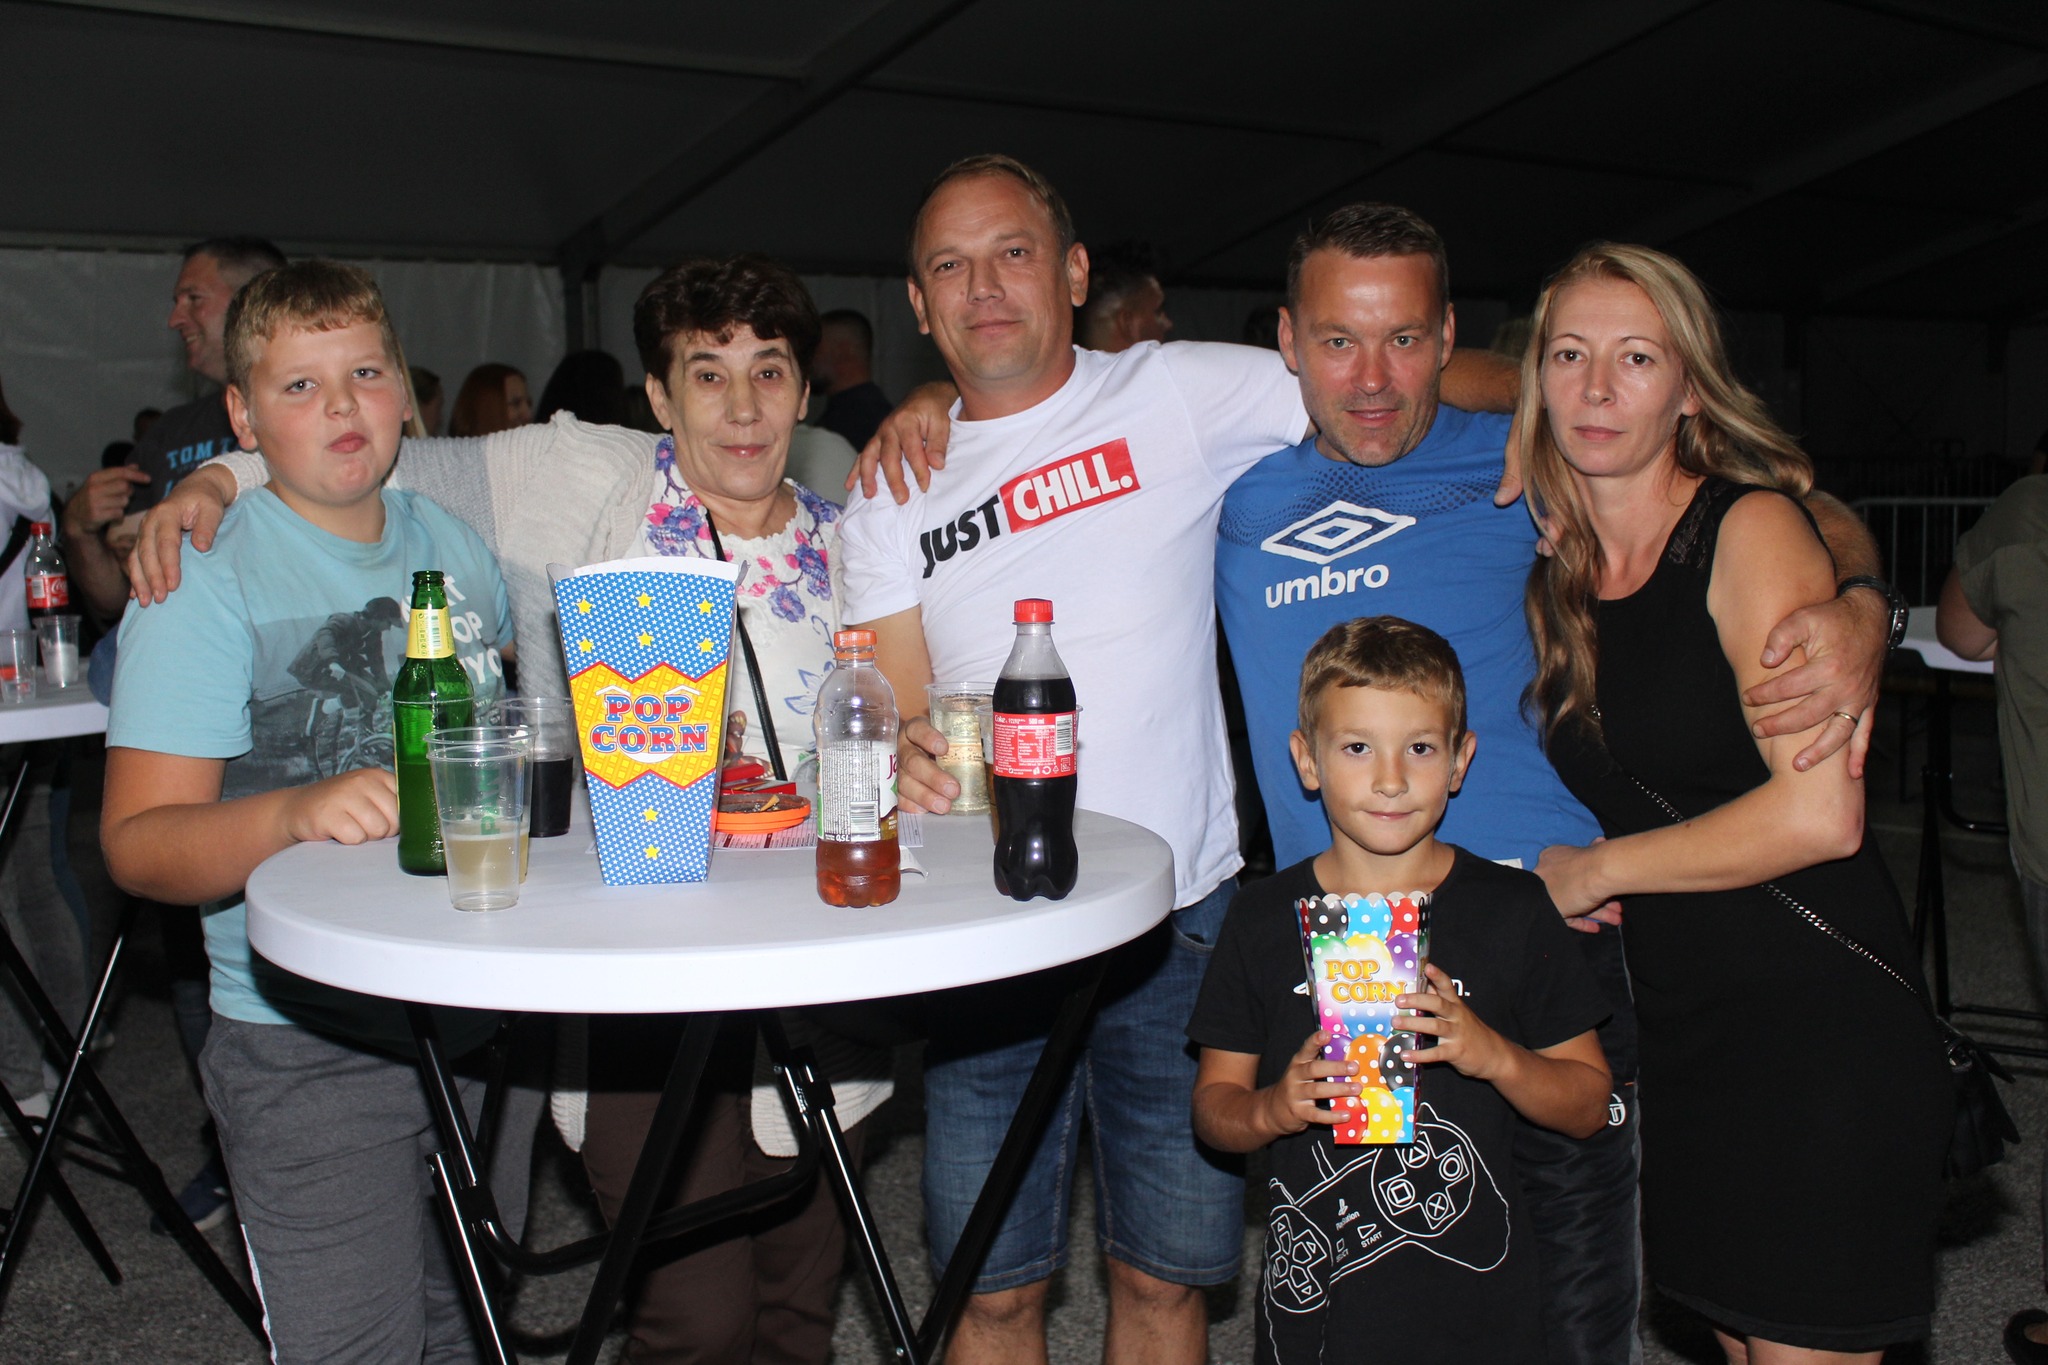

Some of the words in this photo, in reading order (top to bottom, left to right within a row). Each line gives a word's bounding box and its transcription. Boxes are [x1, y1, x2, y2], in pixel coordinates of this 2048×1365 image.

[166, 440, 214, 469] TOM
[920, 494, 1000, 579] JUST
[1012, 452, 1133, 522] CHILL.
[1265, 564, 1389, 608] umbro
[451, 611, 483, 643] OP
[604, 694, 694, 724] POP
[590, 724, 710, 754] CORN
[1324, 959, 1380, 981] POP
[1331, 981, 1408, 1003] CORN
[1361, 1231, 1383, 1248] START
